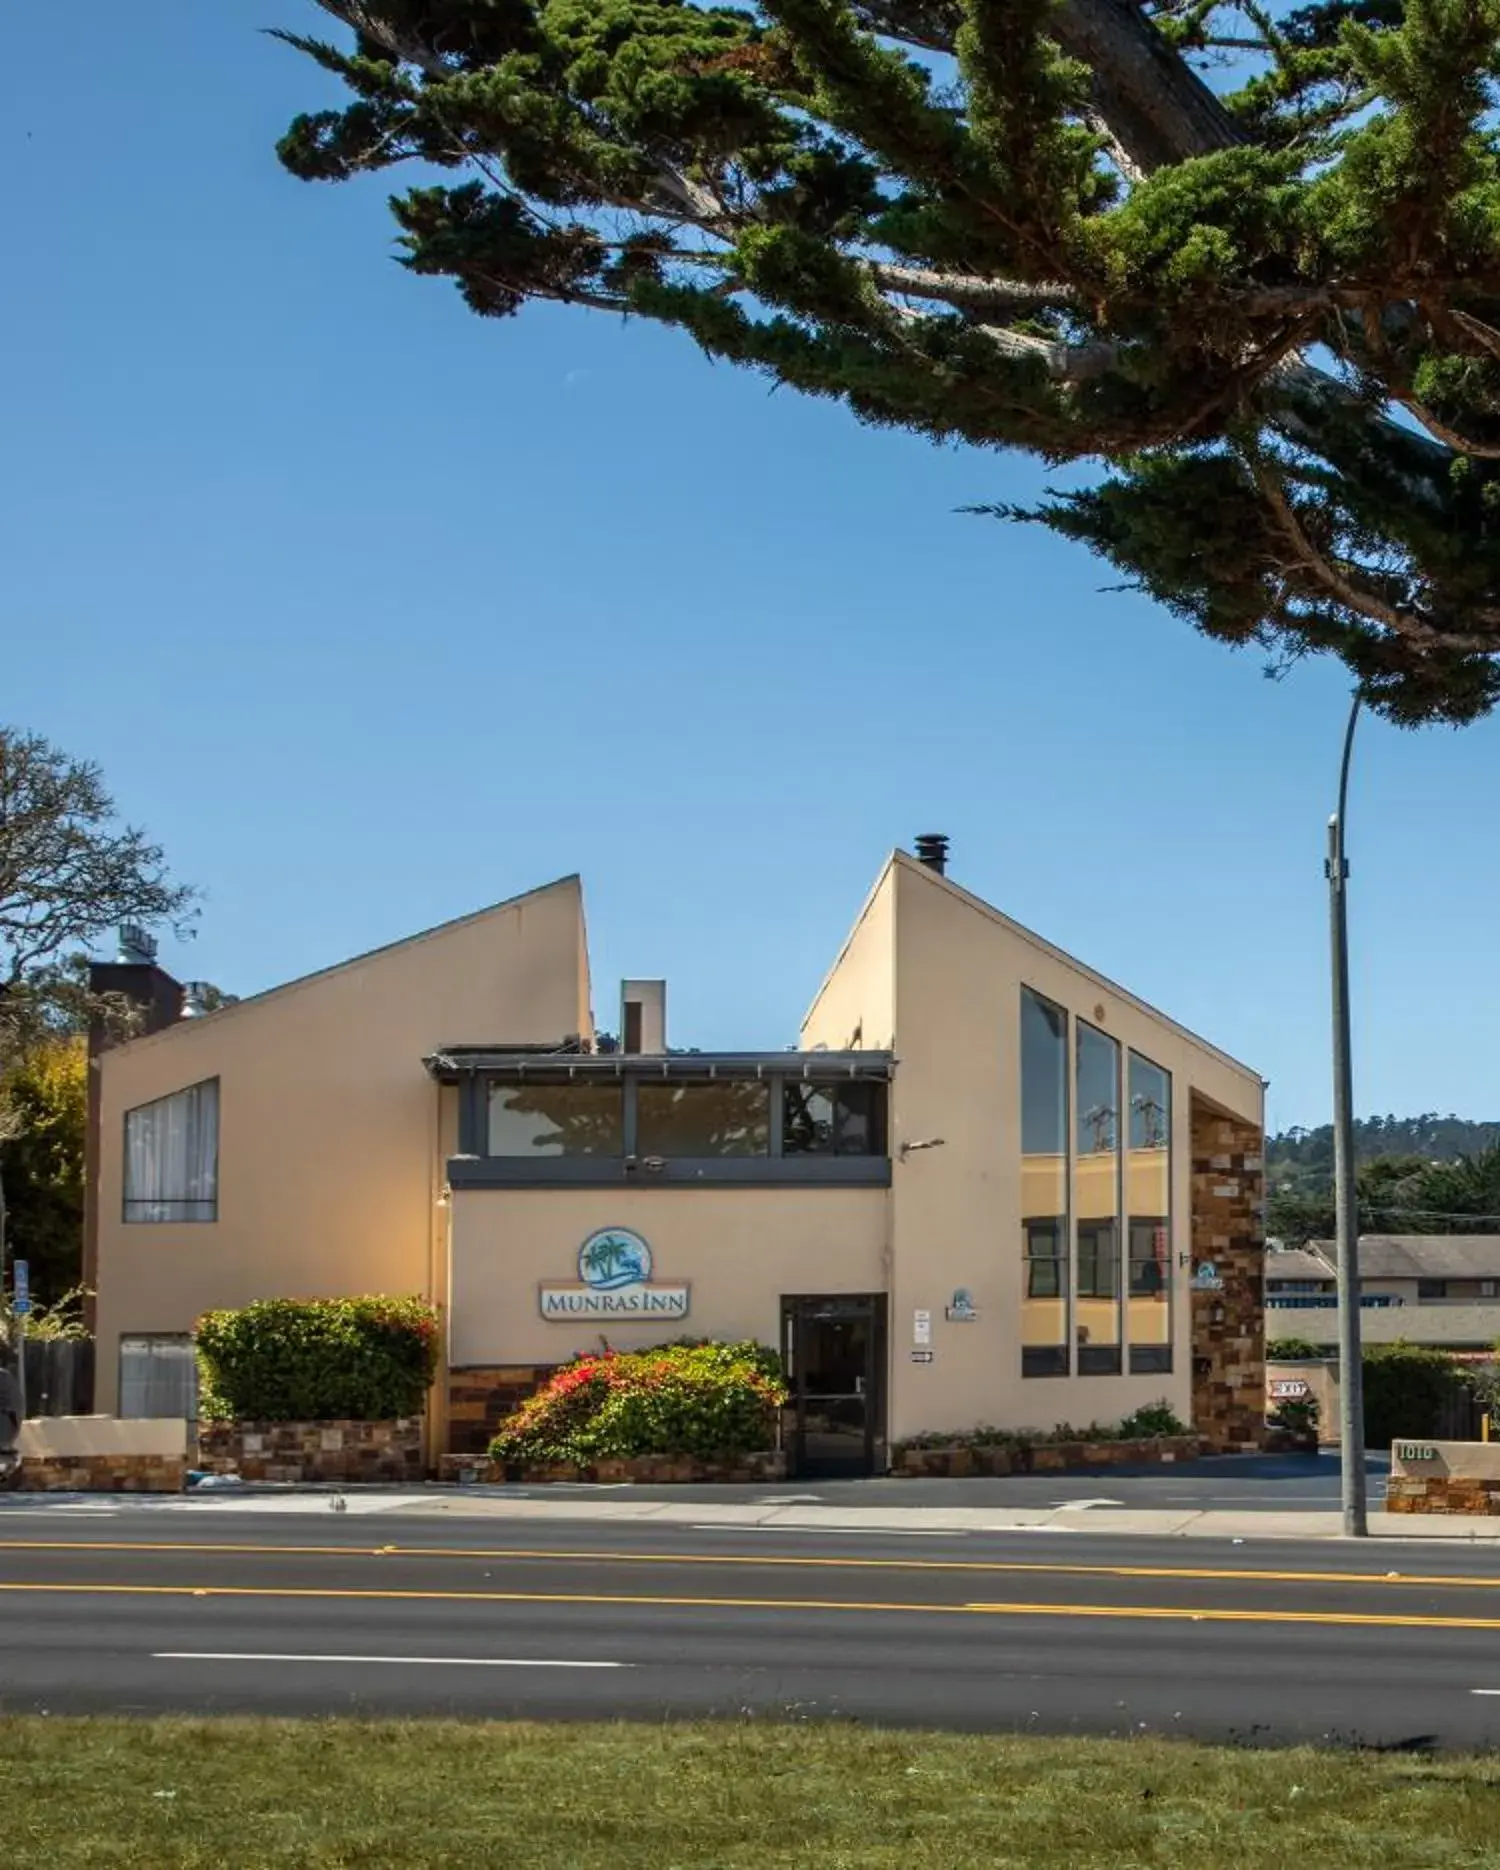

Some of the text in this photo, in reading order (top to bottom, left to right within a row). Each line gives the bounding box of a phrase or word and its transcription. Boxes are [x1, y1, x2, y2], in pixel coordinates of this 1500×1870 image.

[547, 1291, 684, 1312] MUNRAS INN
[1276, 1383, 1304, 1393] EXIT
